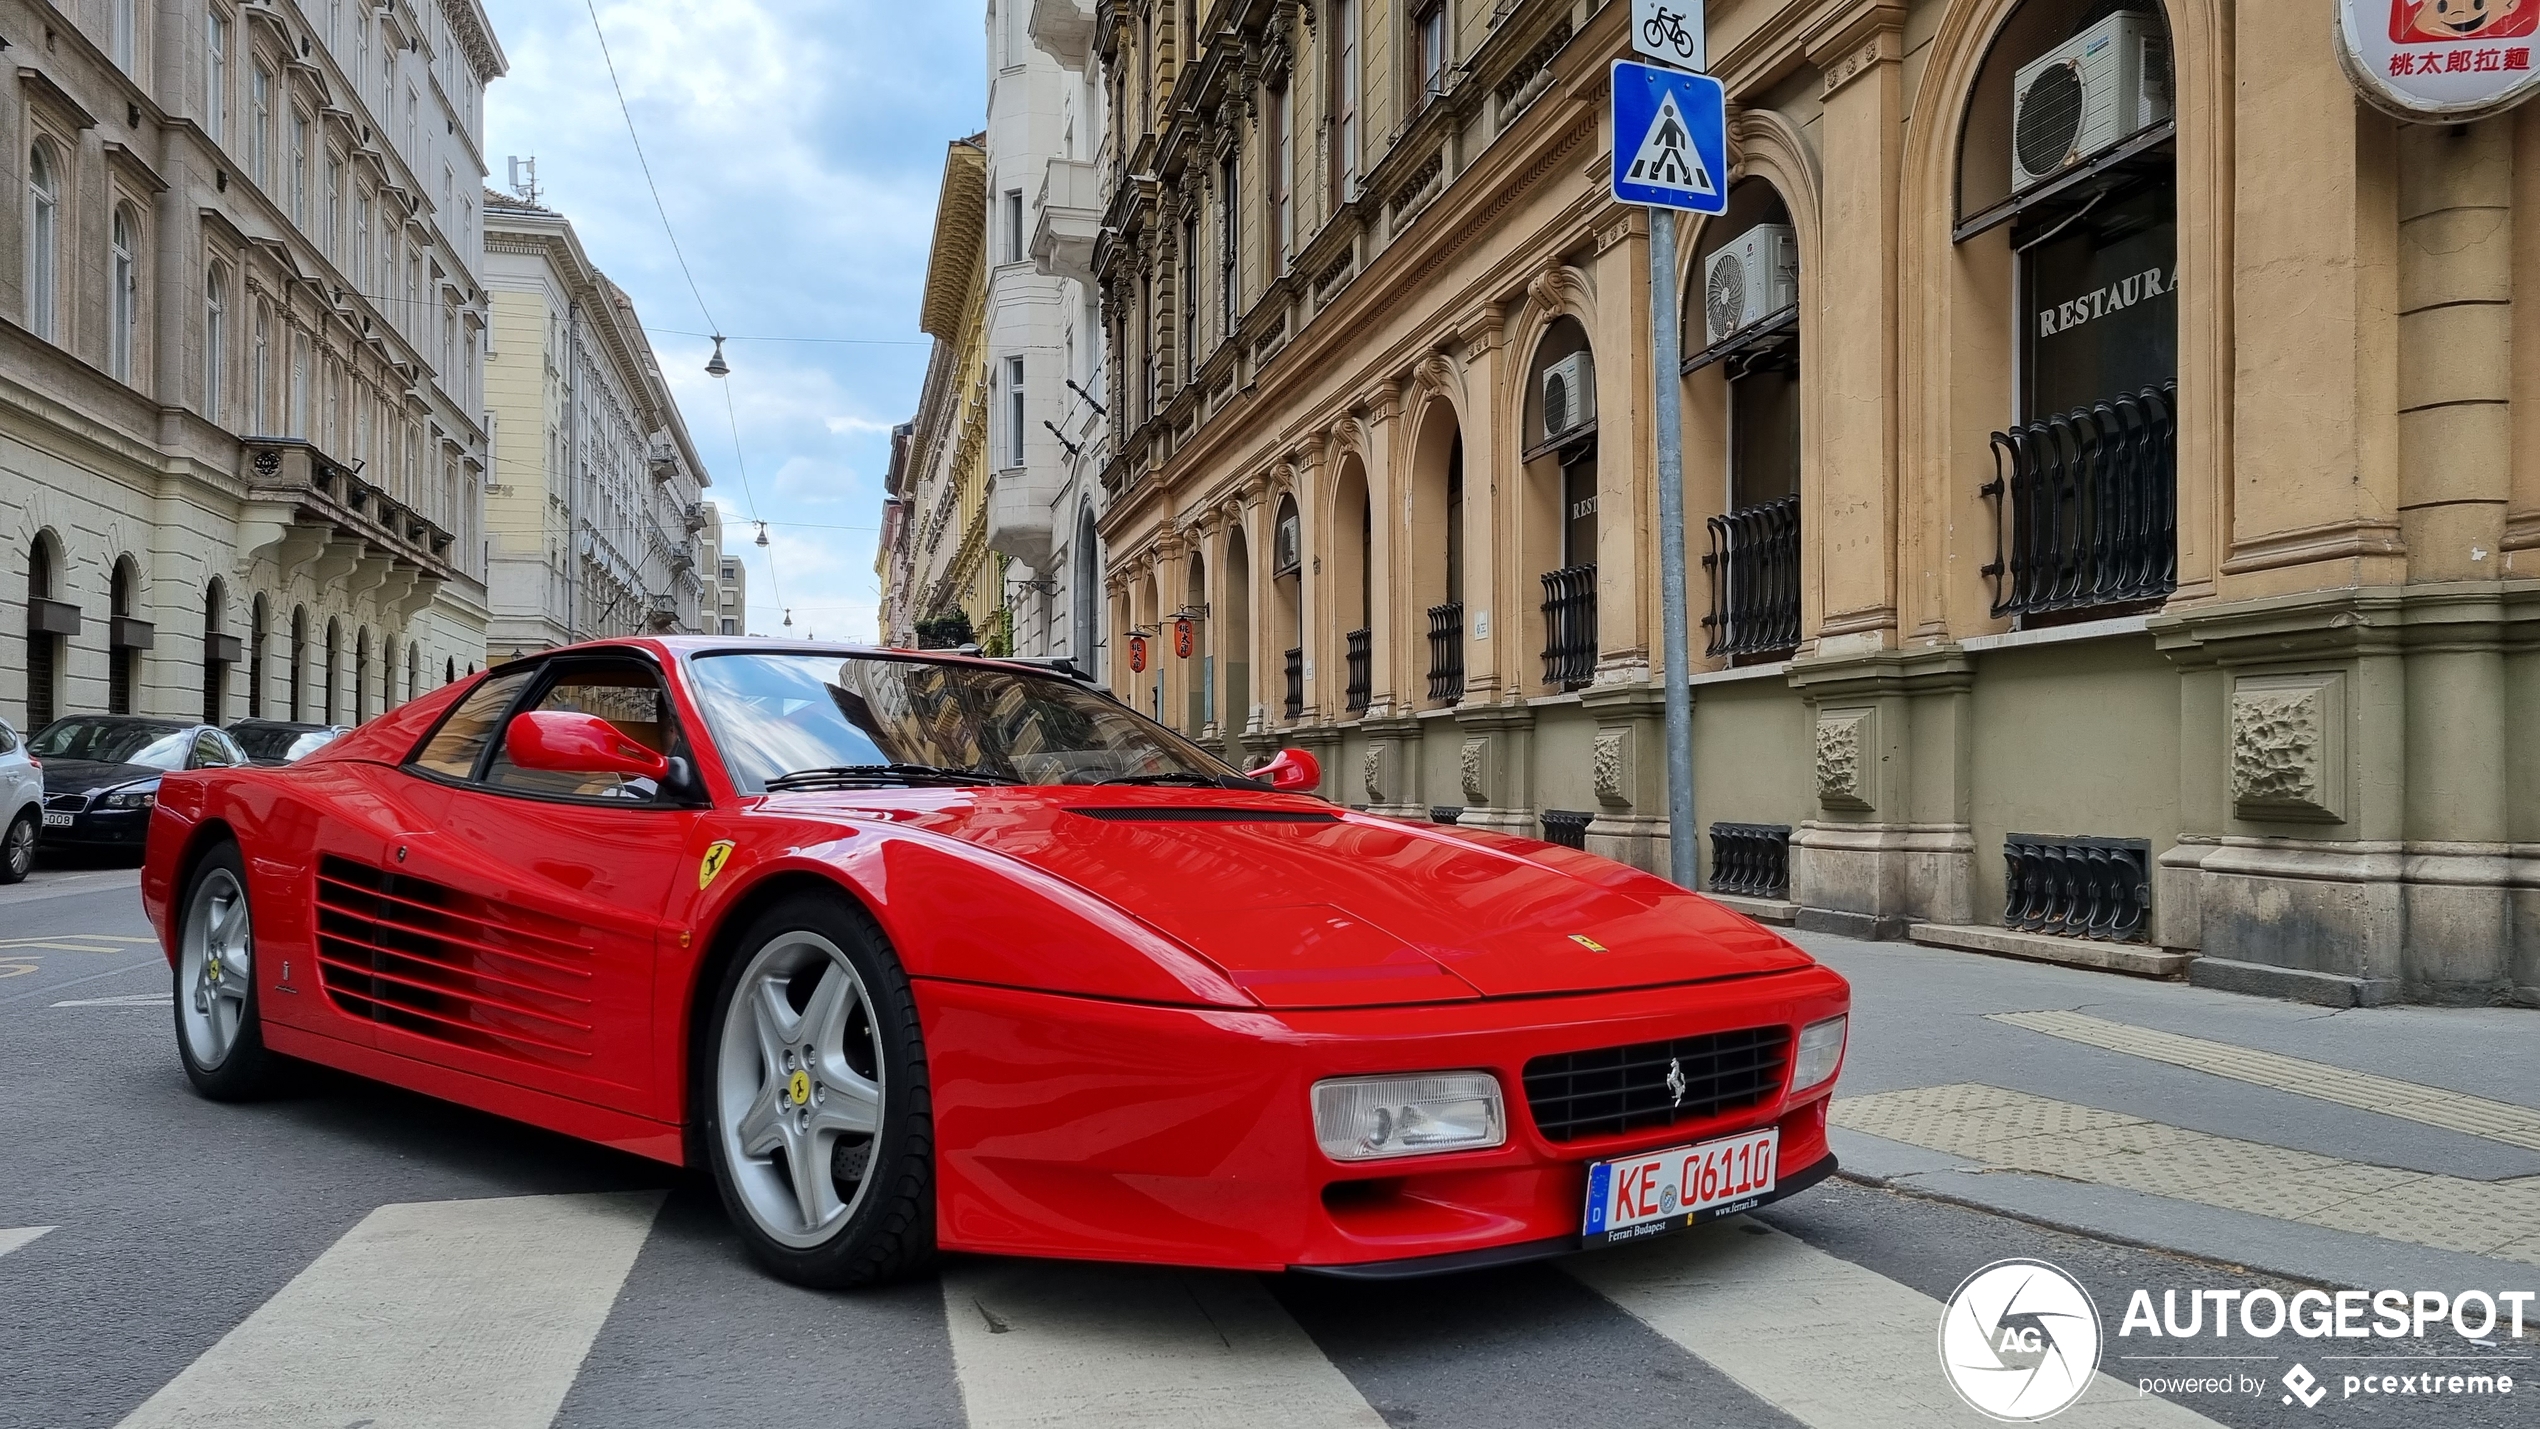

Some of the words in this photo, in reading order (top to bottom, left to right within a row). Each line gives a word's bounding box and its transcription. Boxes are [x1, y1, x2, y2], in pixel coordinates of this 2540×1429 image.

[1615, 1162, 1661, 1222] KE
[1680, 1138, 1770, 1207] 06110
[1592, 1207, 1601, 1223] D
[1715, 1198, 1758, 1217] www.ferrari.hu
[1608, 1226, 1633, 1243] Ferrari
[1634, 1220, 1666, 1237] Budapest
